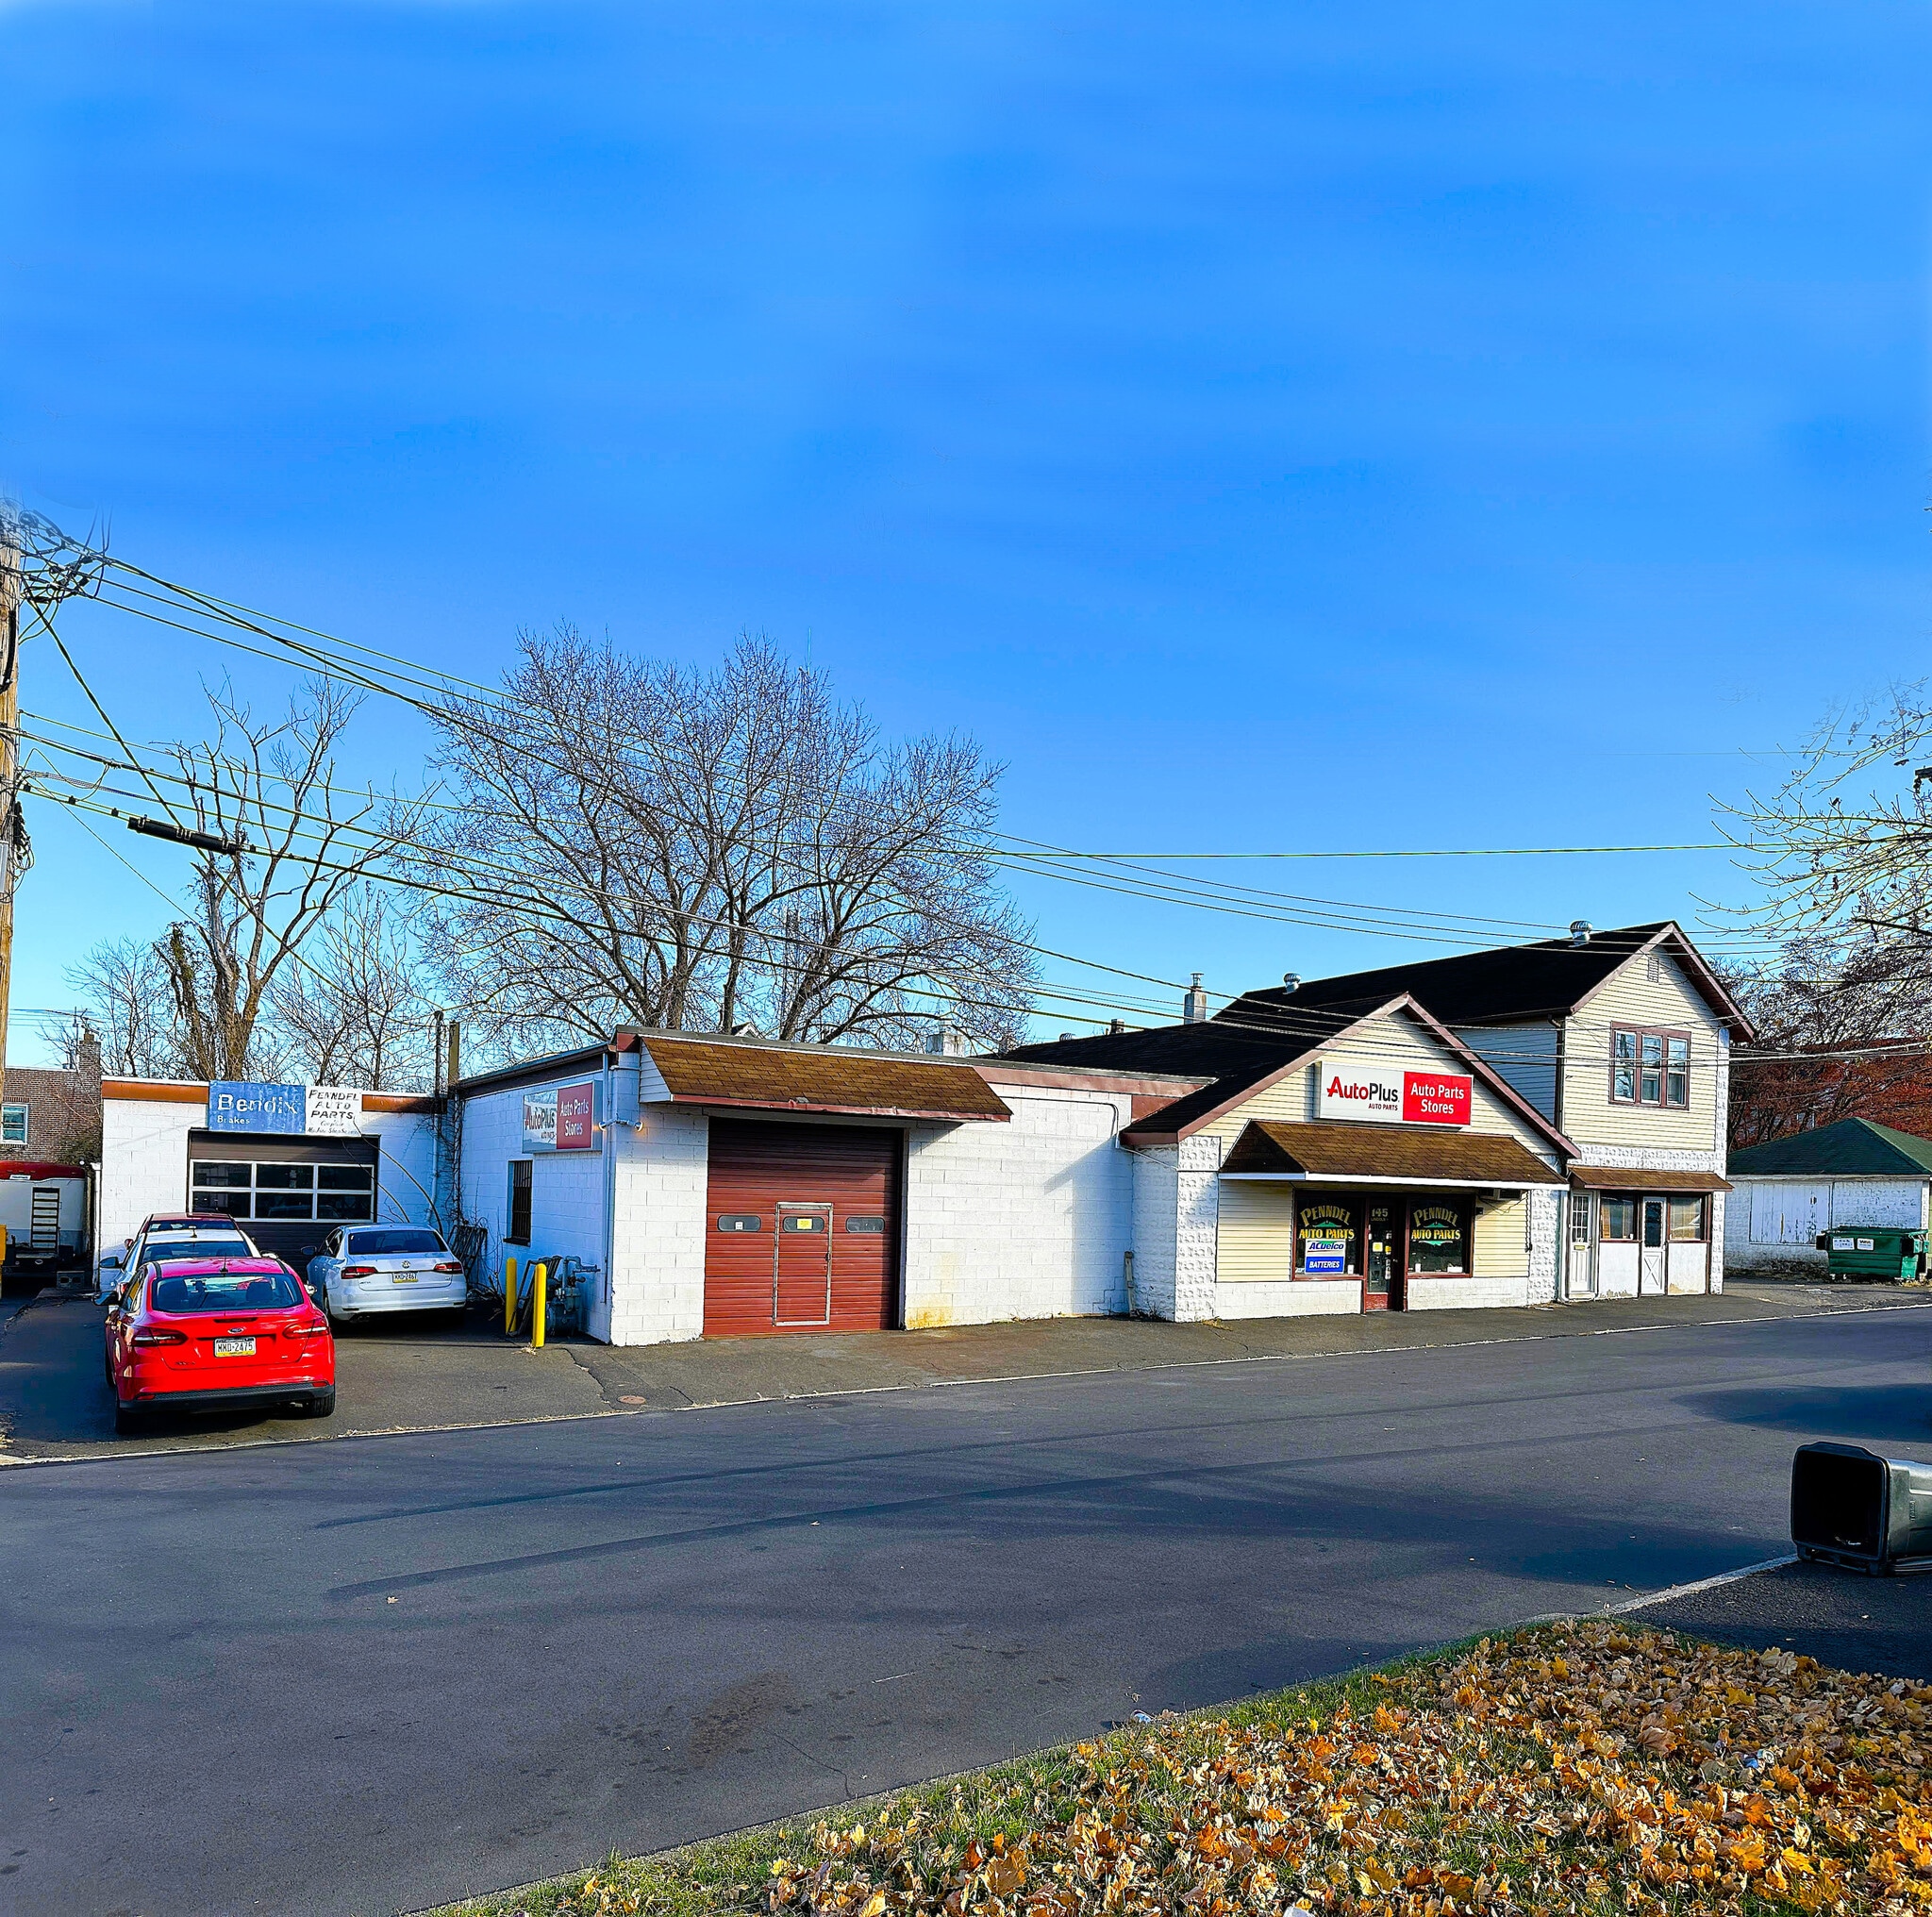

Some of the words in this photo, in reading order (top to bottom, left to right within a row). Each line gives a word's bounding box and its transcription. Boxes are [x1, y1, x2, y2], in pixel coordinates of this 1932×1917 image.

[1326, 1076, 1399, 1102] AutoPlus
[1410, 1082, 1435, 1097] Auto
[1438, 1085, 1465, 1099] Parts
[217, 1093, 297, 1114] Bendix
[315, 1101, 351, 1109] AUTO
[560, 1101, 574, 1117] Auto
[574, 1098, 589, 1115] Parts
[1421, 1099, 1455, 1114] Stores
[217, 1115, 250, 1125] Brakes
[310, 1109, 354, 1120] PARTS
[564, 1120, 583, 1137] Stores
[1300, 1205, 1351, 1227] PENNDEL
[1371, 1208, 1389, 1217] 145
[1413, 1207, 1458, 1227] PENNDEL
[1298, 1228, 1324, 1239] AUTO
[1325, 1228, 1355, 1240] PARTS
[1411, 1229, 1432, 1240] AUTO
[1433, 1229, 1461, 1240] PARTS
[1308, 1260, 1341, 1269] BATTERIES
